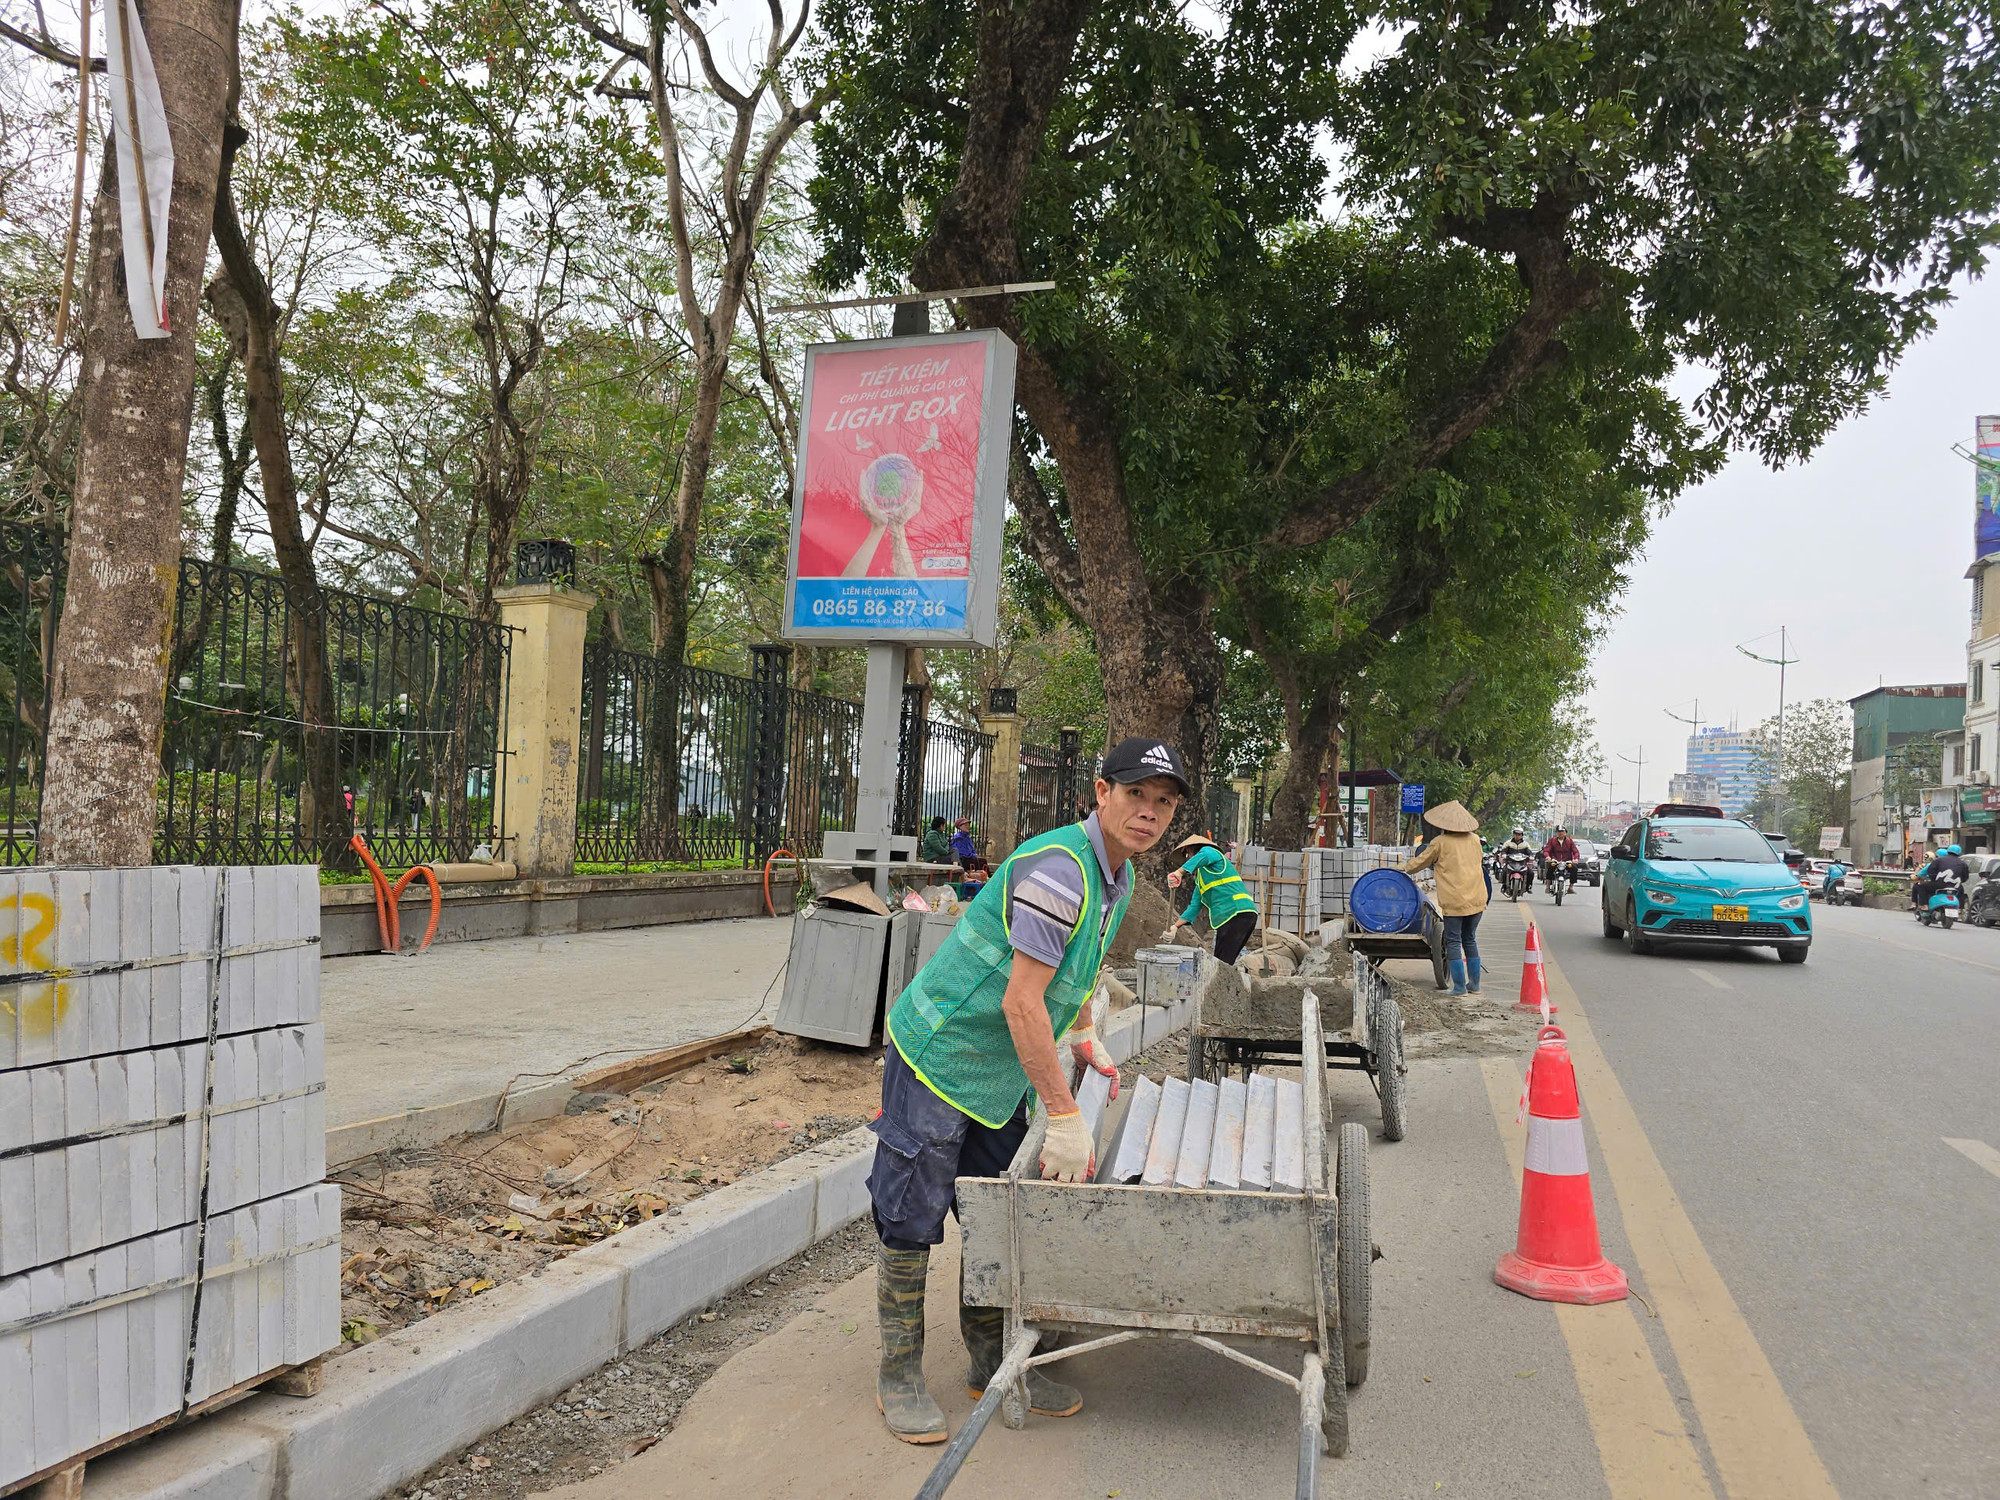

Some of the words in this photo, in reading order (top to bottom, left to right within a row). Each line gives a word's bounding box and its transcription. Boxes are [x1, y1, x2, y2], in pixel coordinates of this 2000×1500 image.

[859, 362, 898, 387] TIẾT
[899, 358, 951, 383] KIỆM
[839, 394, 857, 404] CHI
[922, 380, 945, 392] CÁO
[825, 403, 904, 432] LIGHT
[904, 393, 967, 423] BOX
[842, 586, 860, 596] LIÊN
[861, 586, 872, 597] HỆ
[902, 587, 919, 596] CÁO
[813, 599, 858, 616] 0865
[863, 599, 887, 616] 86
[893, 599, 918, 616] 87
[922, 599, 946, 616] 86
[1140, 757, 1174, 770] adidas
